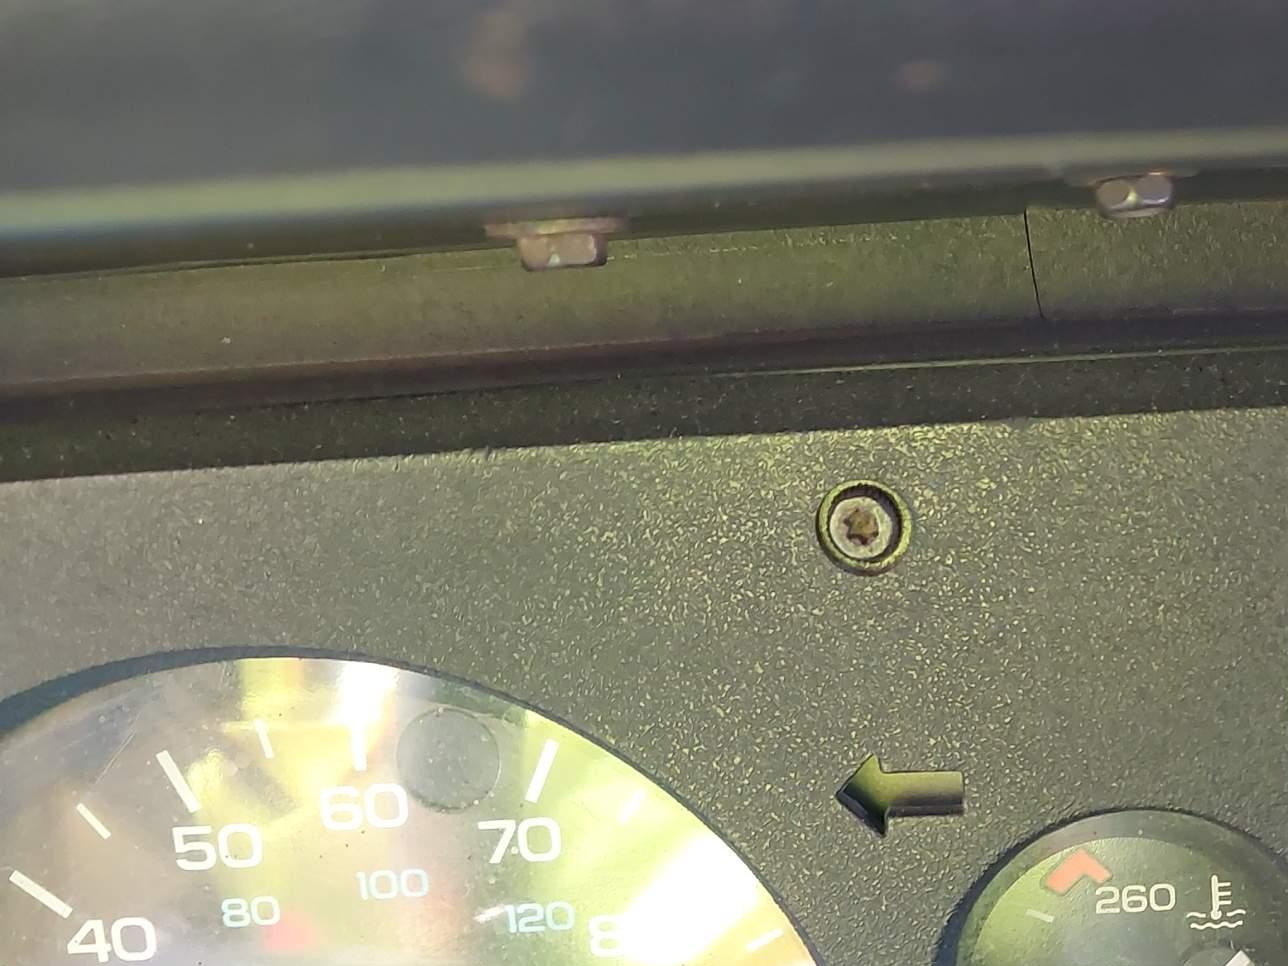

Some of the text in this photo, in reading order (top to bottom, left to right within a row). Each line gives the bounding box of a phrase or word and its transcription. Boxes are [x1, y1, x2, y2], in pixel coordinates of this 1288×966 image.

[319, 783, 409, 831] 60
[172, 823, 263, 871] 50
[477, 817, 562, 864] 70
[356, 869, 430, 900] 100
[1095, 883, 1176, 914] 260
[221, 896, 281, 928] 80
[505, 901, 575, 933] 120
[67, 917, 157, 962] 40
